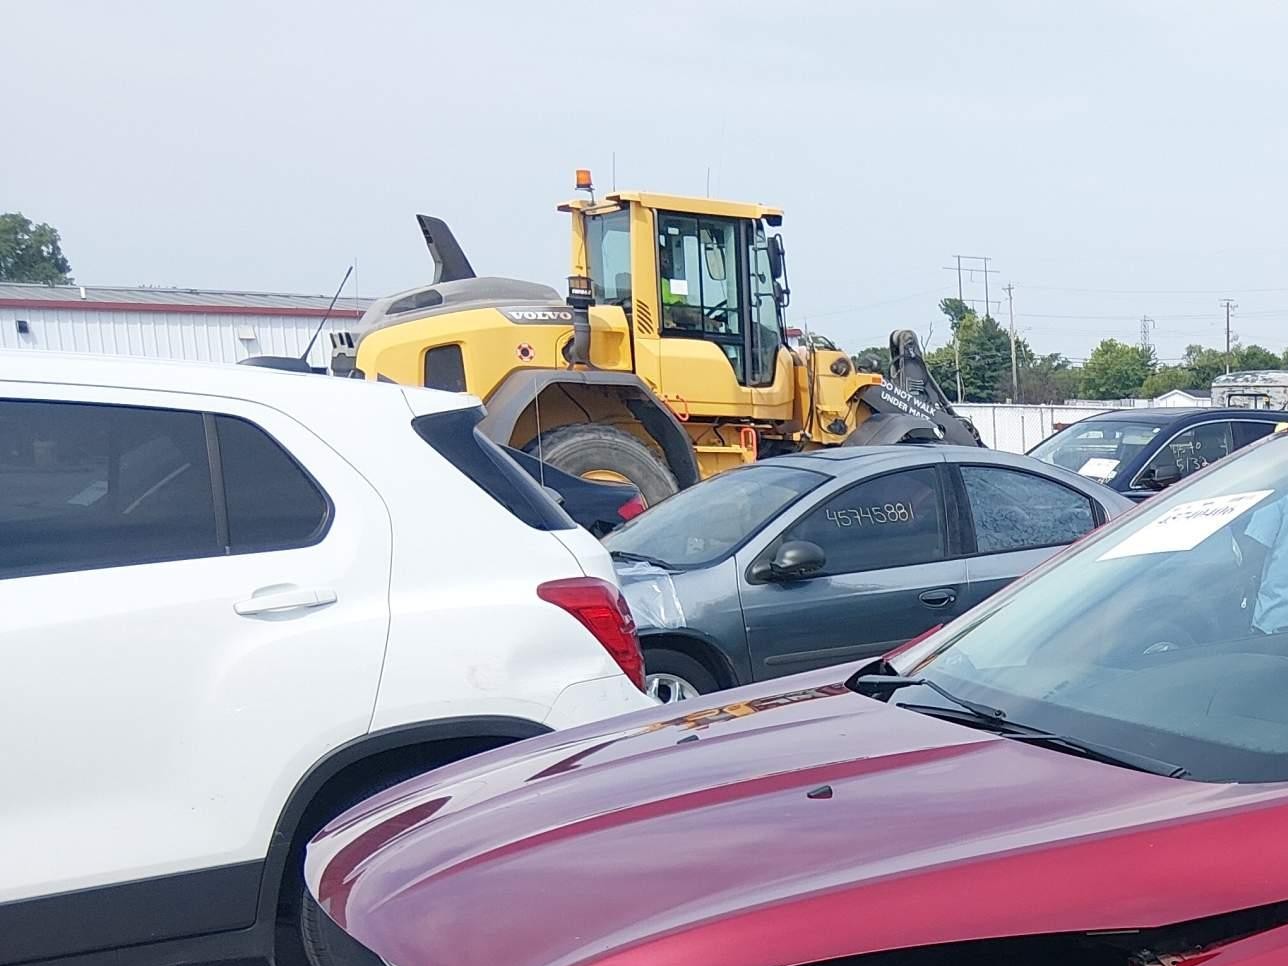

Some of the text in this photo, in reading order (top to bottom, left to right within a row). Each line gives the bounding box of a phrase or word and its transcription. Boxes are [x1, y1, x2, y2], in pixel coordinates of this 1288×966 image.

[509, 311, 572, 320] VOLVO
[880, 378, 936, 416] DO NOT WALK
[881, 391, 907, 412] UNDER
[826, 502, 914, 528] 45745881
